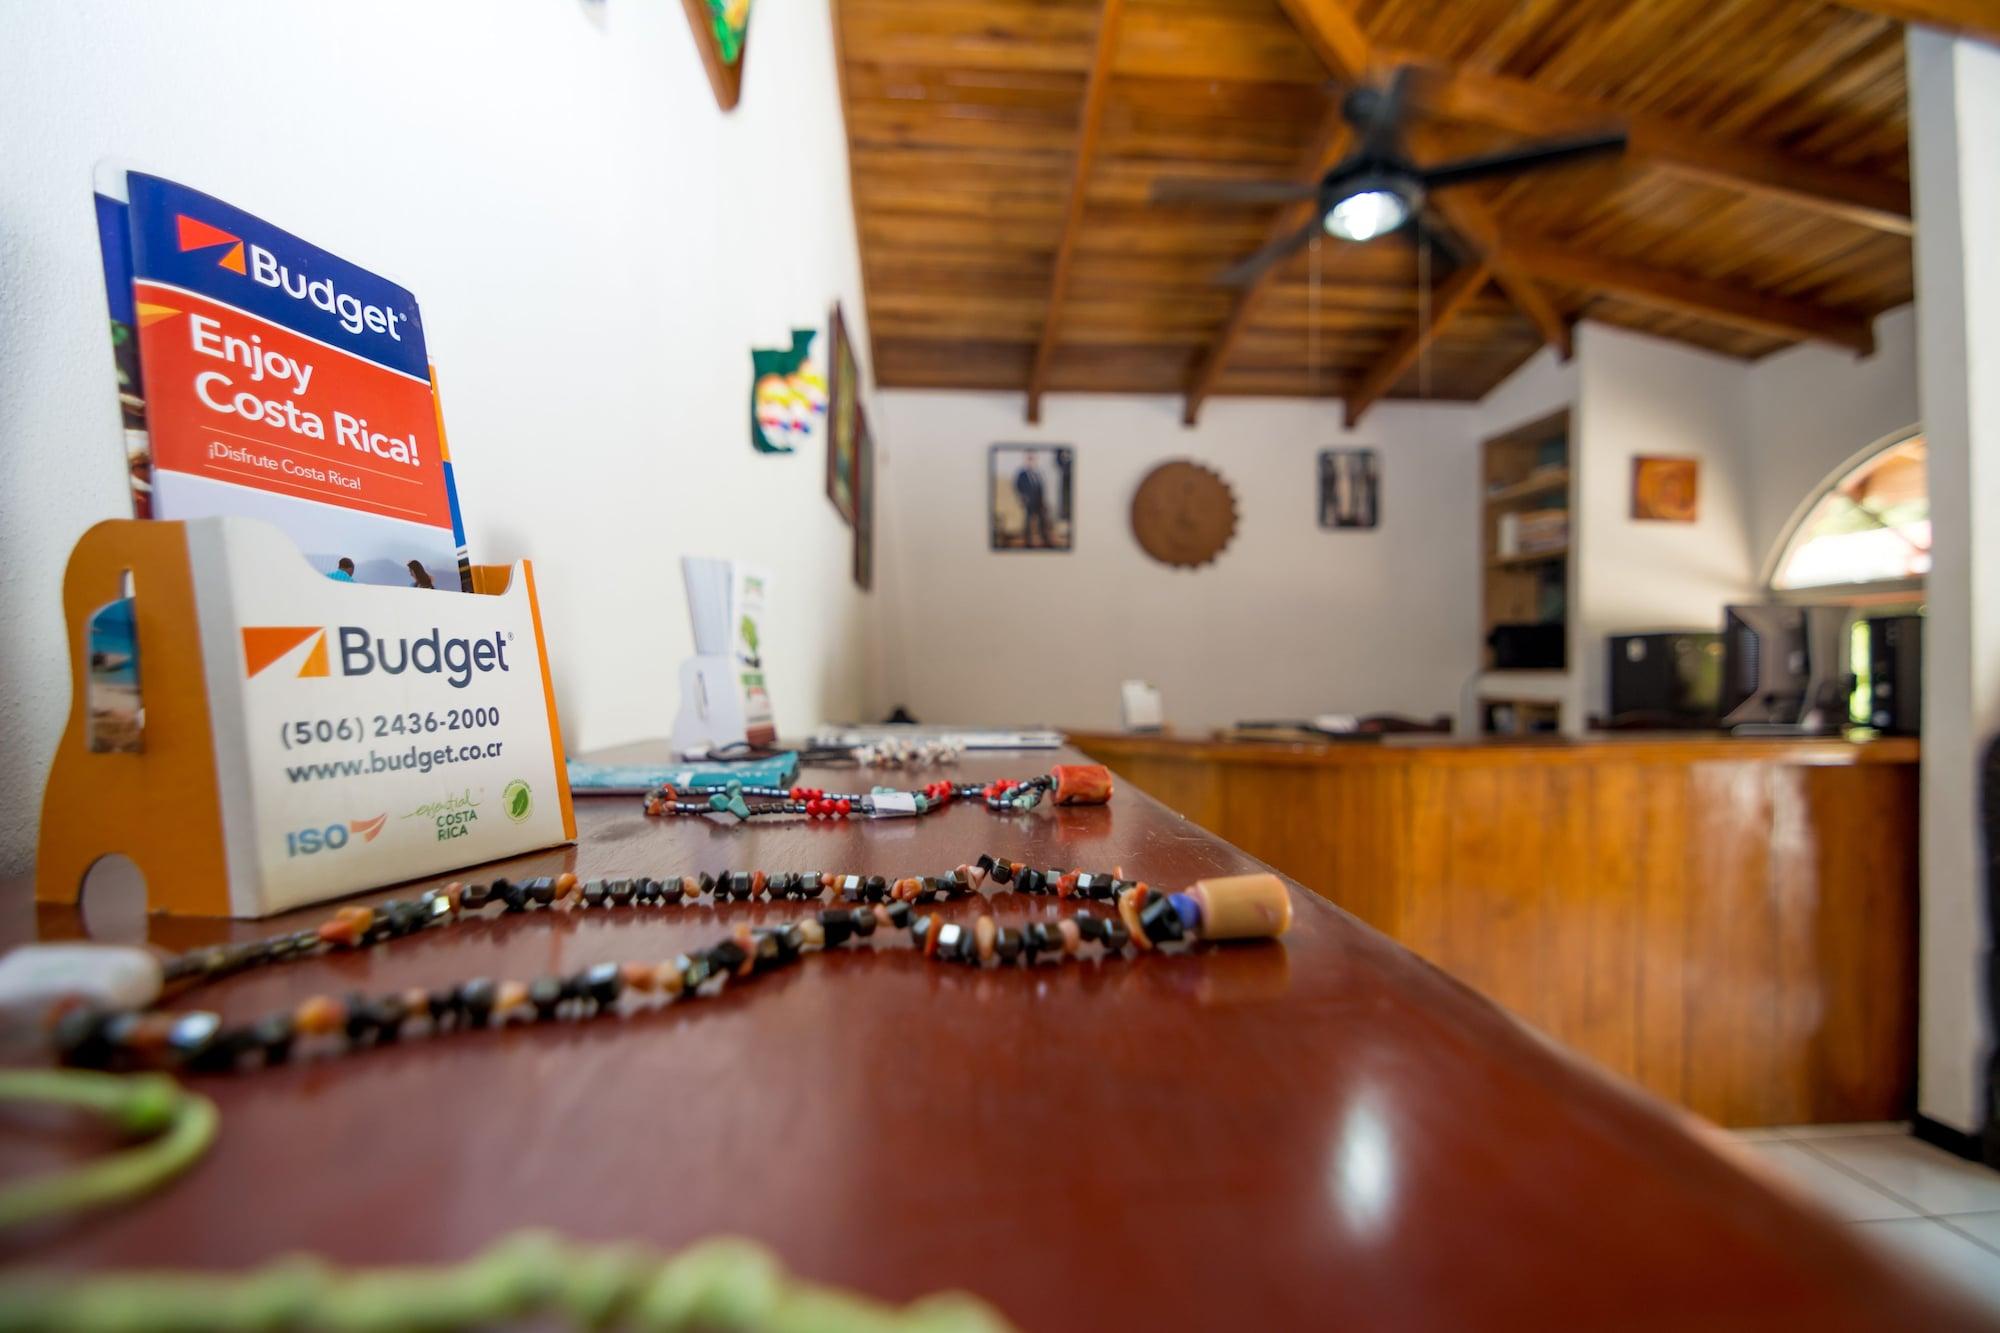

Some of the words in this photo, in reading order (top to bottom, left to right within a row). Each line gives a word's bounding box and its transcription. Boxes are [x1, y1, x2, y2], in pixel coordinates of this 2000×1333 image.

[189, 312, 314, 396] Enjoy
[194, 370, 325, 441] Costa
[333, 410, 421, 468] Rica!
[208, 440, 279, 472] ¡Disfrute
[281, 457, 326, 483] Costa
[328, 469, 361, 491] Rica!
[281, 716, 365, 750] (506)
[373, 706, 501, 738] 2436-2000
[286, 740, 504, 784] www.budget.co.cr
[286, 822, 350, 860] ISO
[436, 810, 478, 828] COSTA
[437, 824, 469, 842] RICA
